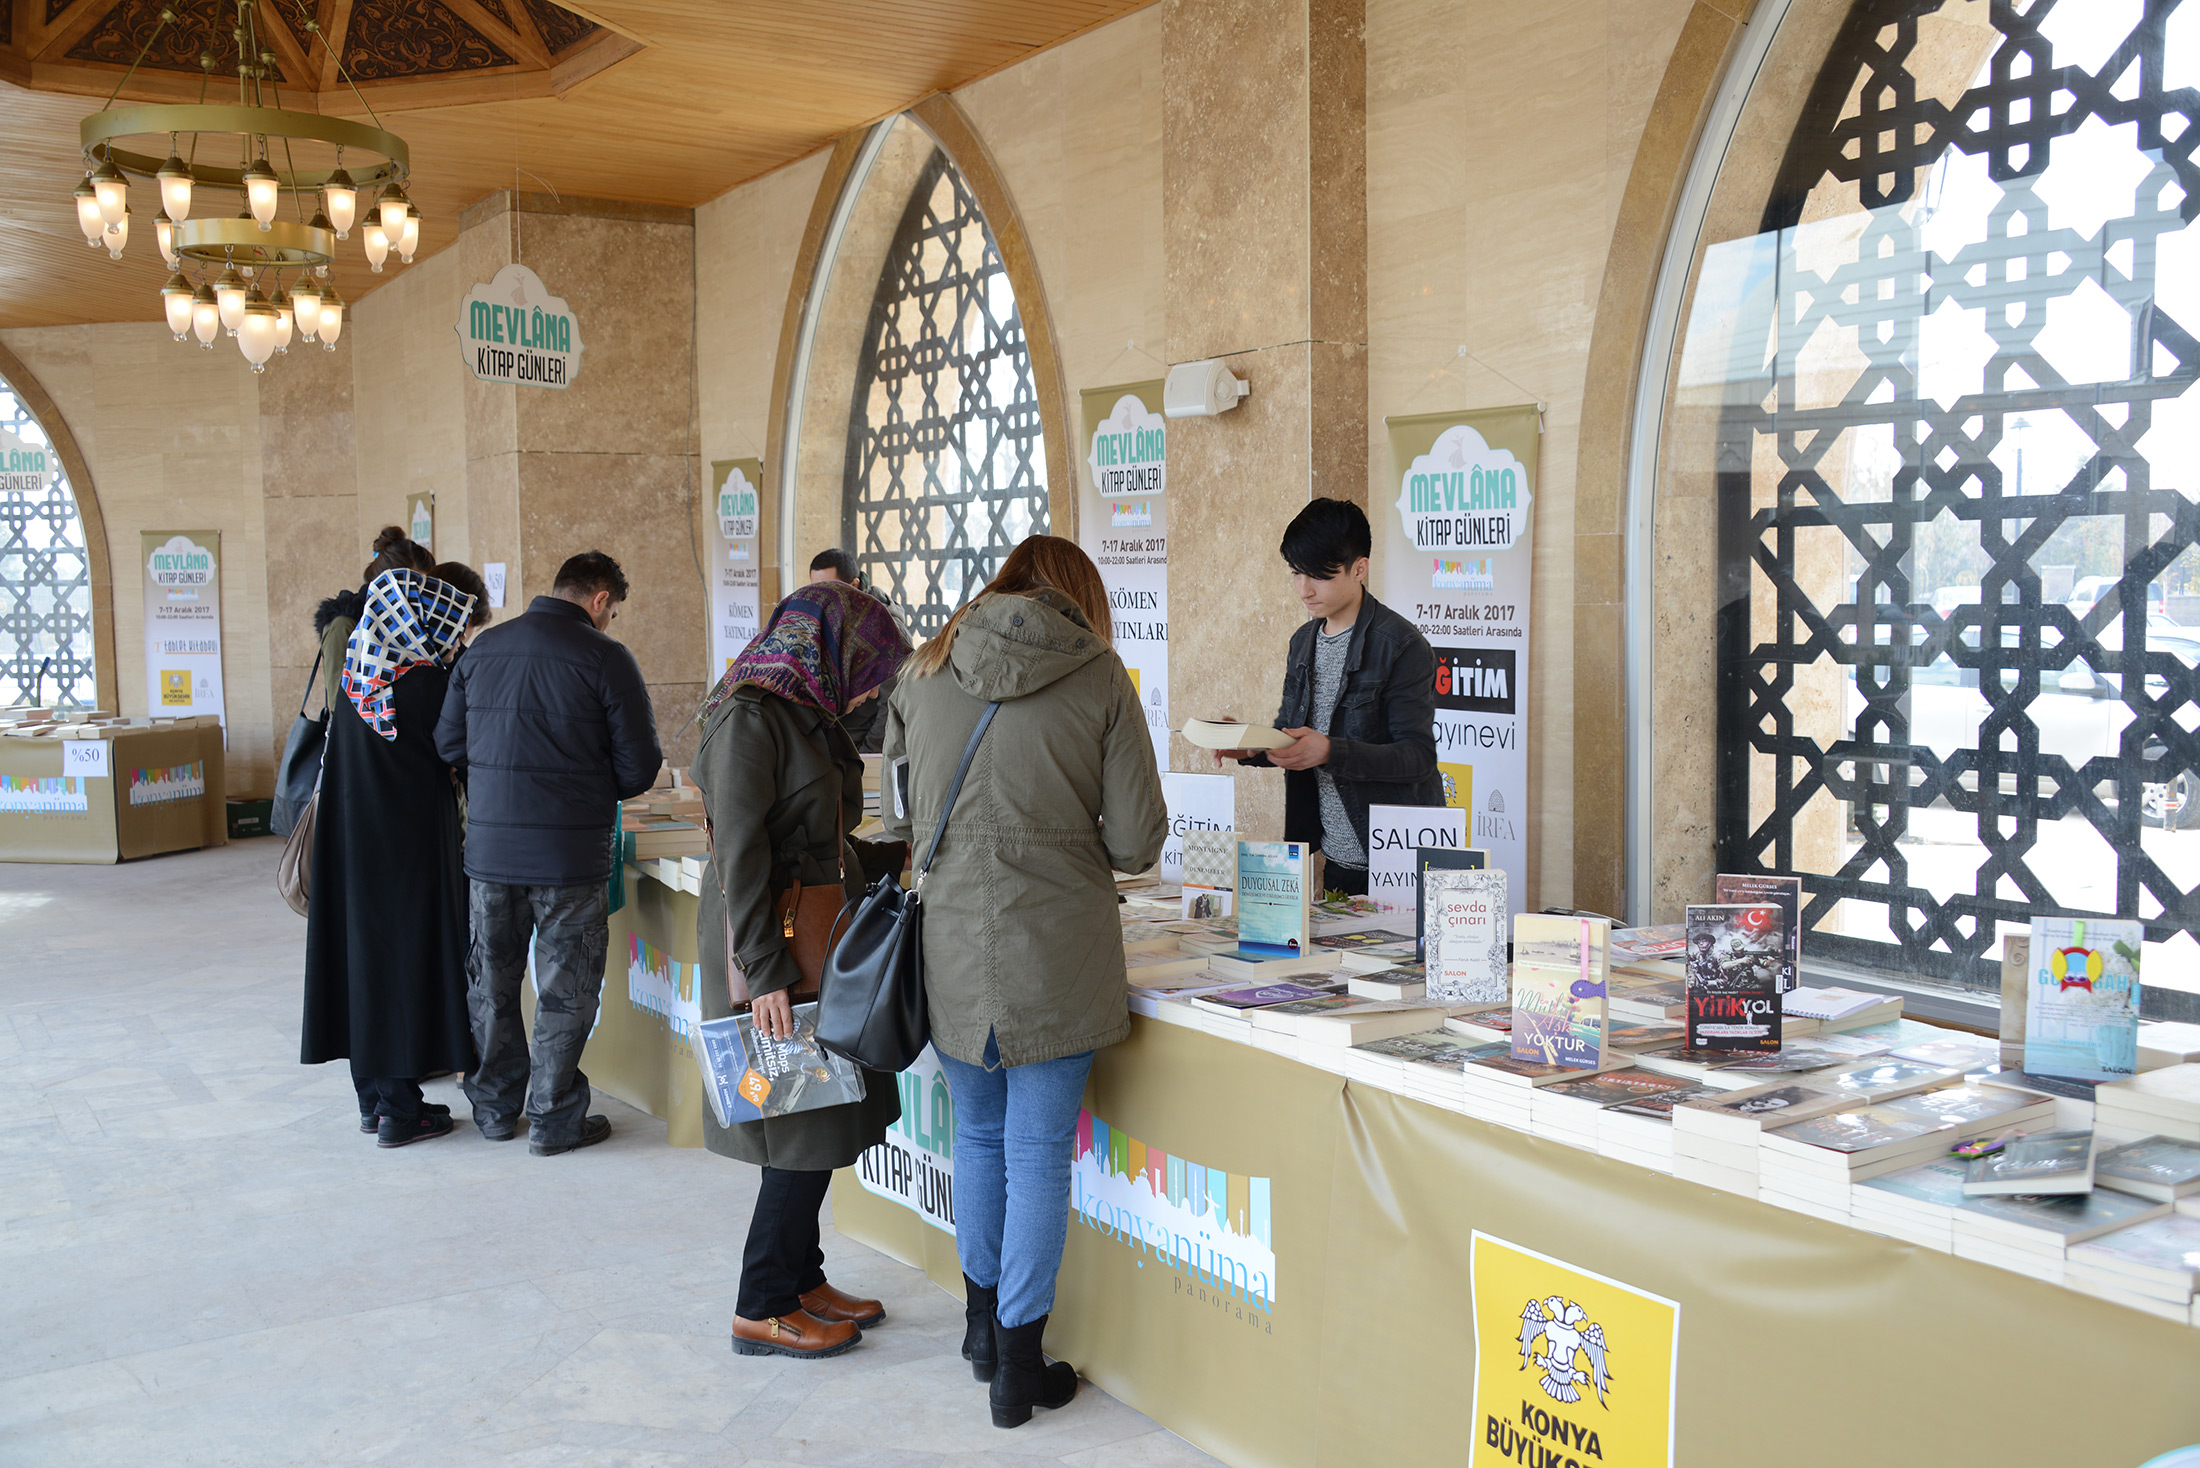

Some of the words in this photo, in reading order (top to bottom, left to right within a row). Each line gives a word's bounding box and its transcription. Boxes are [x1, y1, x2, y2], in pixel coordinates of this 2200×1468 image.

[470, 300, 570, 353] MEVLÂNA
[478, 345, 514, 378] KİTAP
[518, 349, 566, 385] GÜNLERİ
[1097, 425, 1165, 466] MEVLÂNA
[0, 448, 46, 472] LÂNA
[1102, 468, 1125, 493] KİTAP
[1126, 464, 1162, 492] GÜNLERİ
[1410, 464, 1517, 513] MEVLÂNA
[721, 490, 755, 516] MEVLÂNA
[1417, 516, 1452, 546] KİTAP
[1455, 513, 1511, 545] GÜNLERİ
[1102, 540, 1119, 553] 7-17
[1120, 538, 1144, 552] Aralık
[1145, 538, 1165, 552] 2017
[154, 552, 209, 570] MEVLÂNA
[1147, 556, 1167, 564] Arasınd
[158, 571, 177, 584] KİTAP
[179, 570, 207, 584] GÜNLERİ
[1109, 587, 1158, 610] KÖMEN
[729, 602, 754, 619] KÖMEN
[1416, 604, 1441, 620] 7-17
[1444, 604, 1480, 621] Aralık
[1484, 605, 1515, 621] 2017
[1453, 625, 1484, 636] Saatleri
[1486, 626, 1522, 637] Arasında
[1435, 656, 1509, 699] ĞİTİM
[1432, 721, 1516, 750] ayınevi
[71, 748, 100, 762] %50
[0, 797, 87, 819] onyanüma
[1477, 811, 1516, 841] İRFA
[1372, 827, 1457, 850] SALON
[1165, 848, 1183, 866] KİT
[1241, 876, 1281, 892] DUYGUSAL
[1281, 877, 1300, 893] ZEKÂ
[1371, 871, 1418, 887] YAYIN
[1447, 900, 1487, 913] sevda
[1448, 915, 1486, 928] çınarı
[1693, 994, 1747, 1017] YİTİK
[1742, 999, 1774, 1014] YOL
[1516, 1046, 1539, 1055] SALON
[1524, 1032, 1585, 1053] YOKTUR
[775, 1042, 790, 1073] Mbps
[2101, 1065, 2133, 1075] SALON
[915, 1153, 955, 1225] GÜNL
[1077, 1171, 1273, 1314] konyanüma
[1174, 1275, 1272, 1335] panorama
[1521, 1399, 1603, 1461] KONYA
